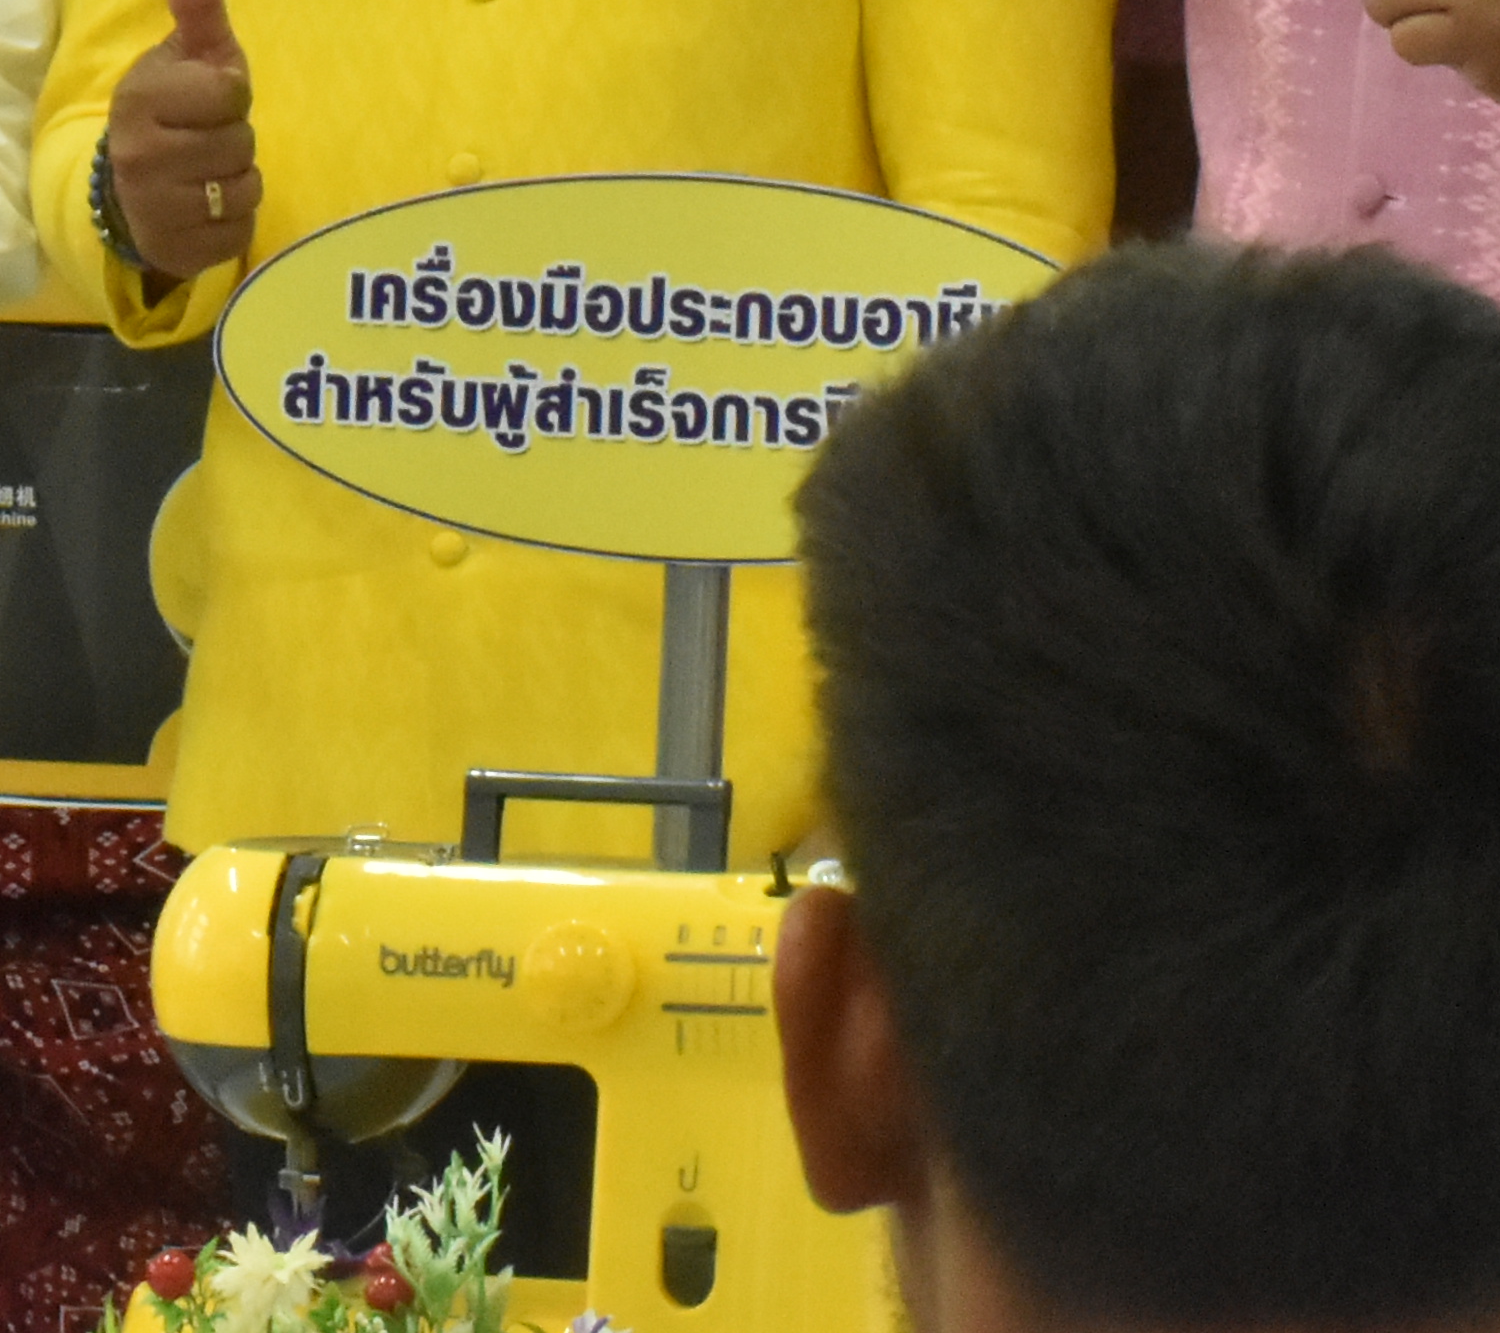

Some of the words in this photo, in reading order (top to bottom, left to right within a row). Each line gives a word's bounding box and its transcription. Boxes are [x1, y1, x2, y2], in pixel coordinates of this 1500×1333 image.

[350, 244, 1006, 347] เครื่องมือประกอบอาชี
[379, 943, 516, 989] butterfly
